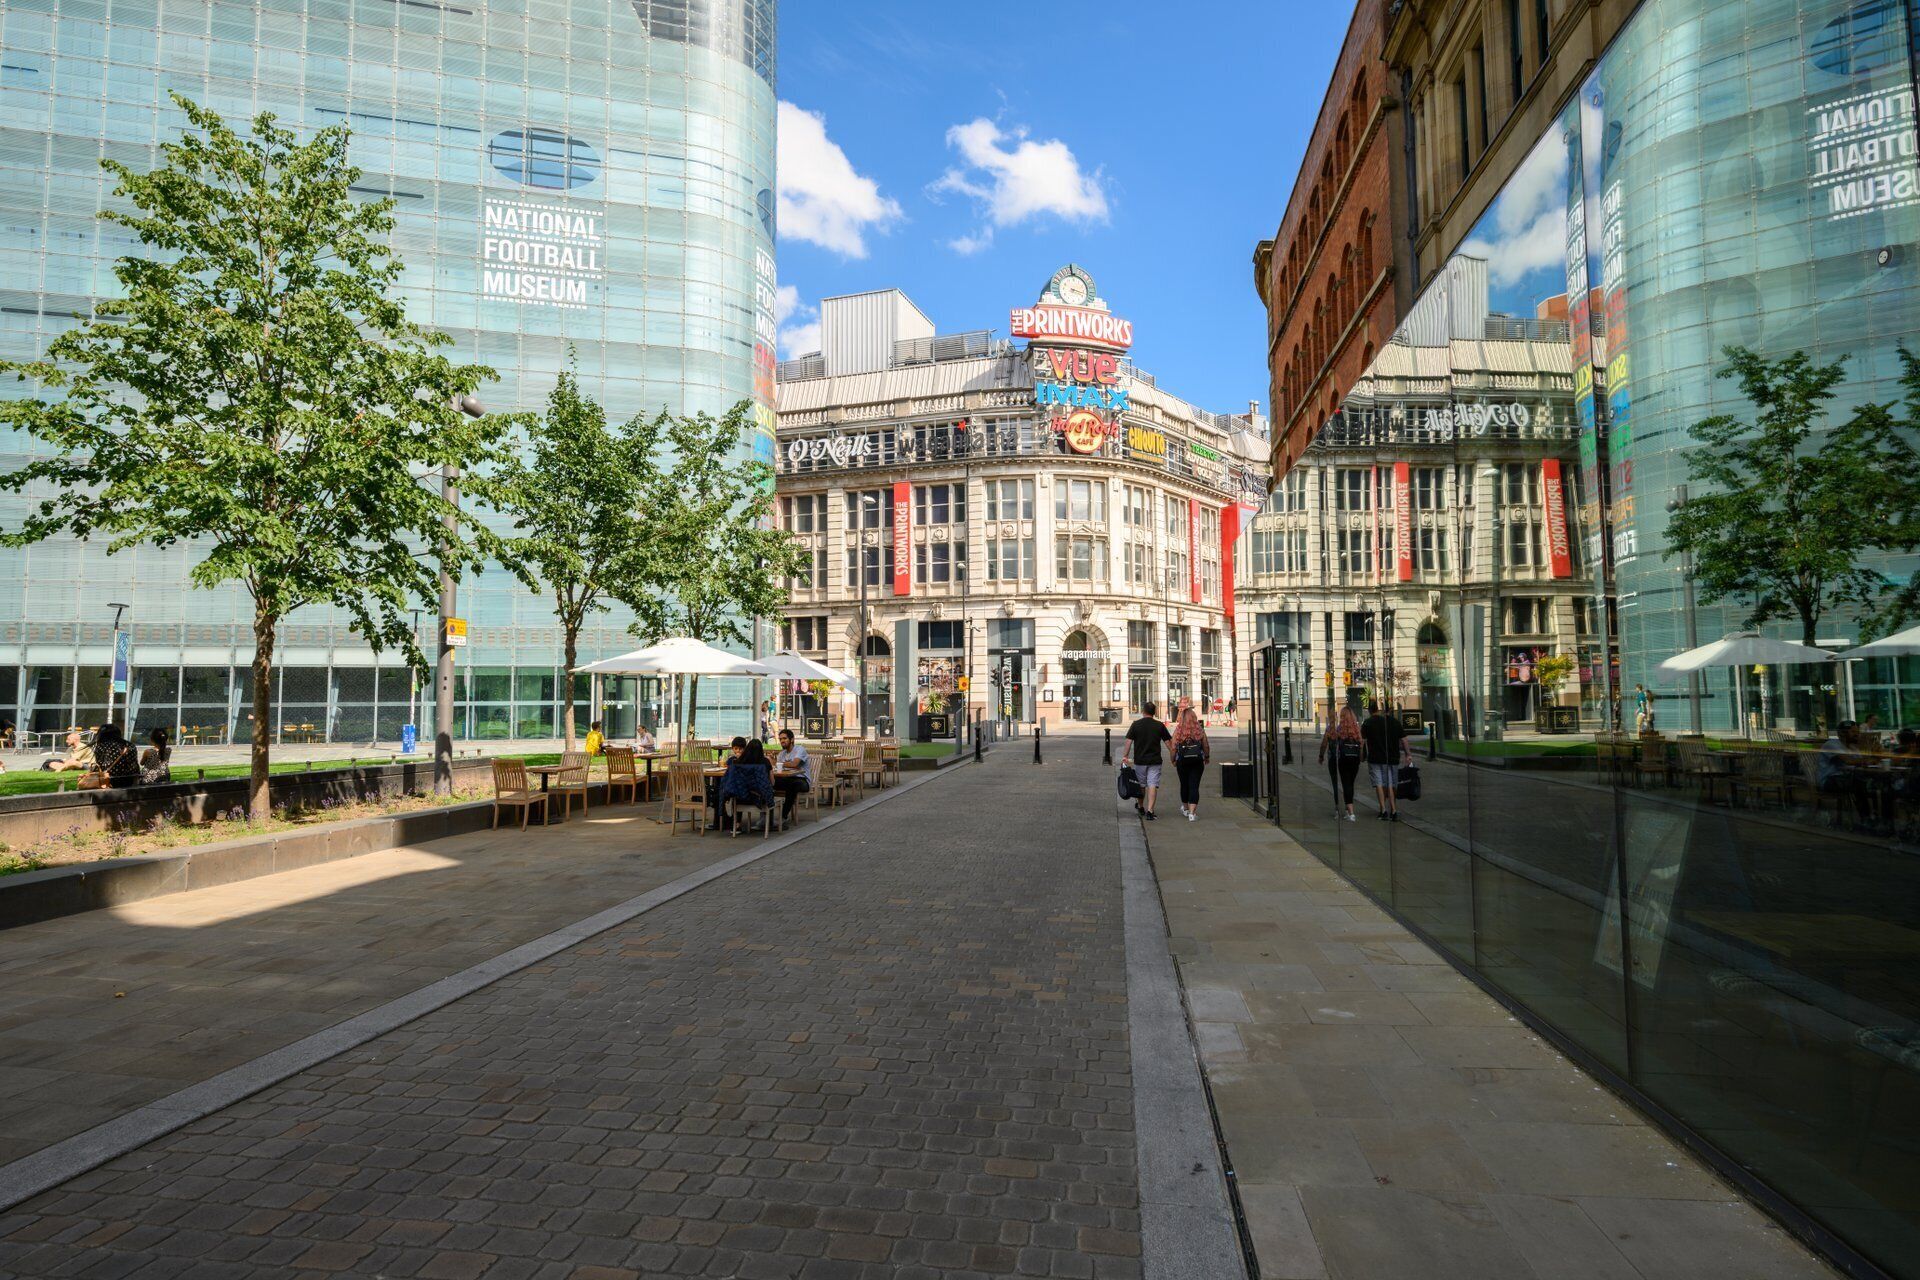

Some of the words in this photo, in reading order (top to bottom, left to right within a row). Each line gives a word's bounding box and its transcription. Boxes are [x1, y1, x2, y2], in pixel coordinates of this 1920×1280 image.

[485, 205, 601, 241] NATIONAL
[484, 238, 602, 272] FOOTBALL
[483, 271, 587, 303] MUSEUM
[1011, 310, 1023, 333] THE
[1023, 309, 1132, 345] PRINTWORKS
[1036, 382, 1131, 411] IMAX
[1050, 416, 1086, 434] Hard
[1086, 419, 1119, 439] Rock
[1128, 426, 1166, 455] CHIQUITO
[788, 433, 873, 466] O'Neill's
[896, 509, 909, 576] PRINTWORKS
[1060, 650, 1111, 660] wagamama
